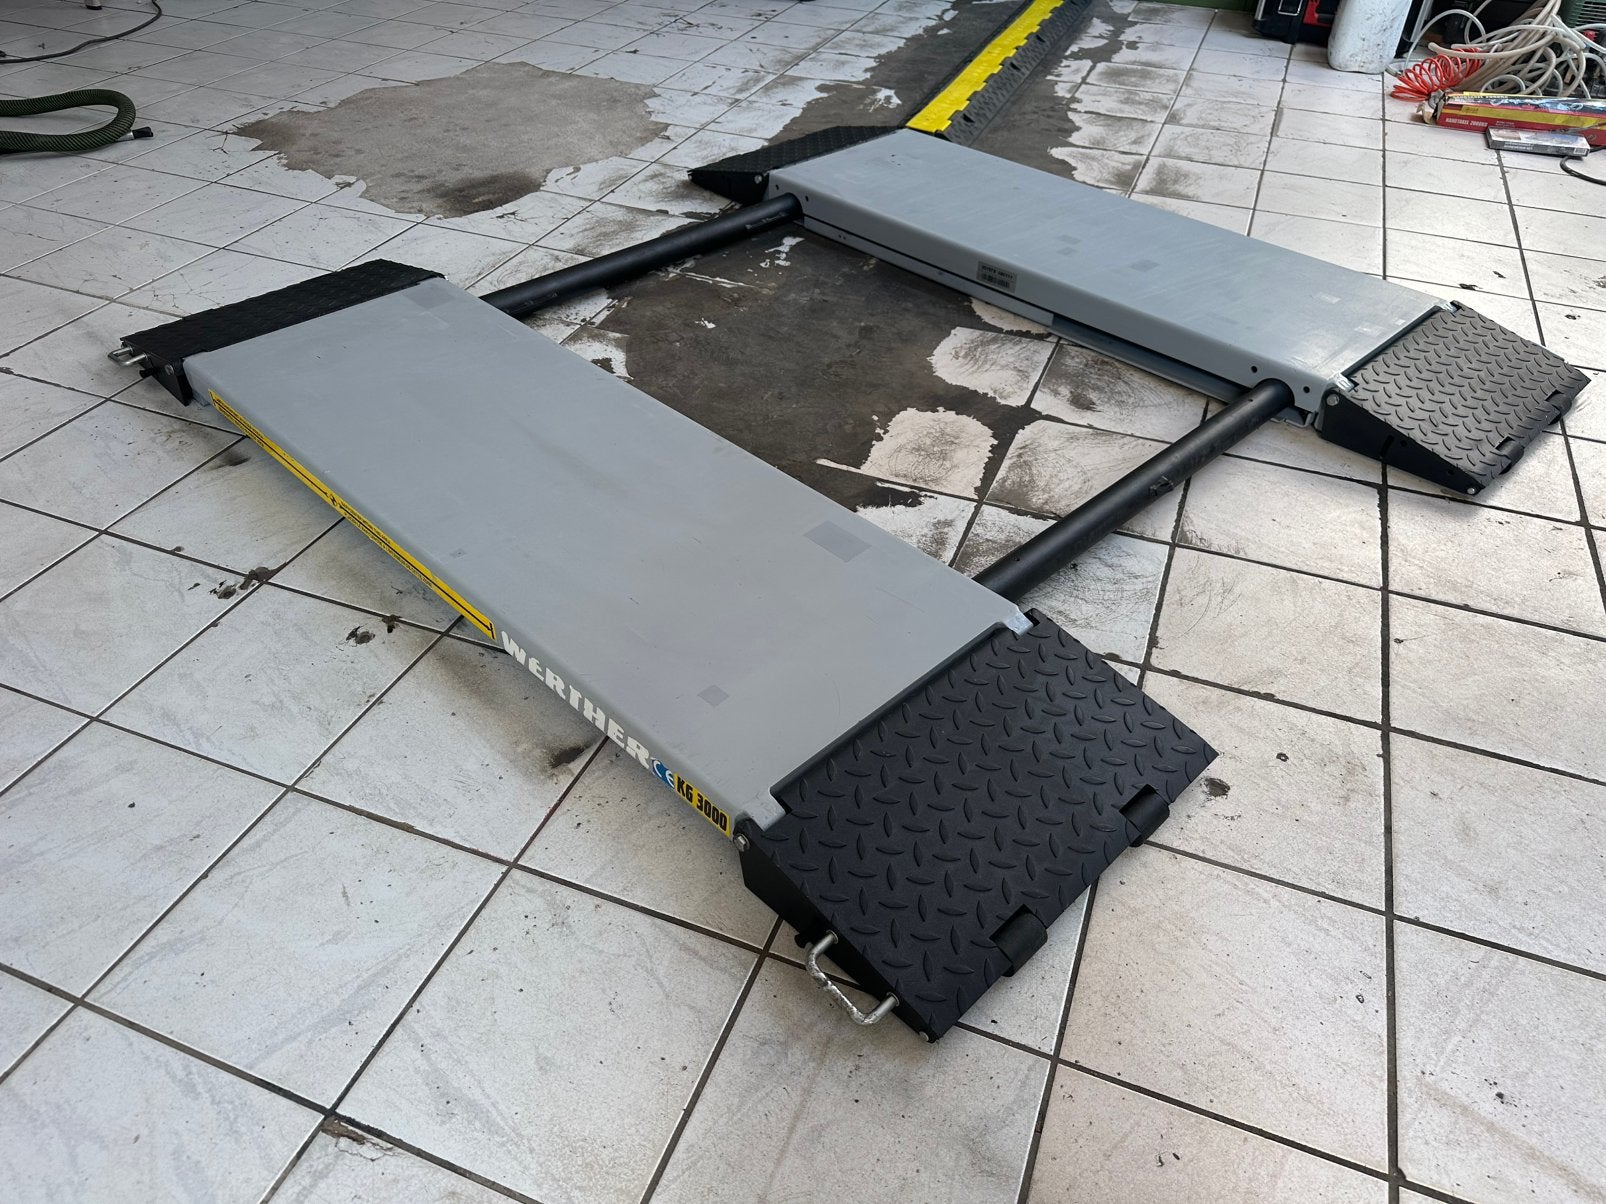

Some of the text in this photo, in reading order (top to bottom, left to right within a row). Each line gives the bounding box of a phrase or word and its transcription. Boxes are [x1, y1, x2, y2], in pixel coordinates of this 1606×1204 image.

[501, 631, 650, 769] WERTHER
[676, 776, 728, 832] KG 3000
